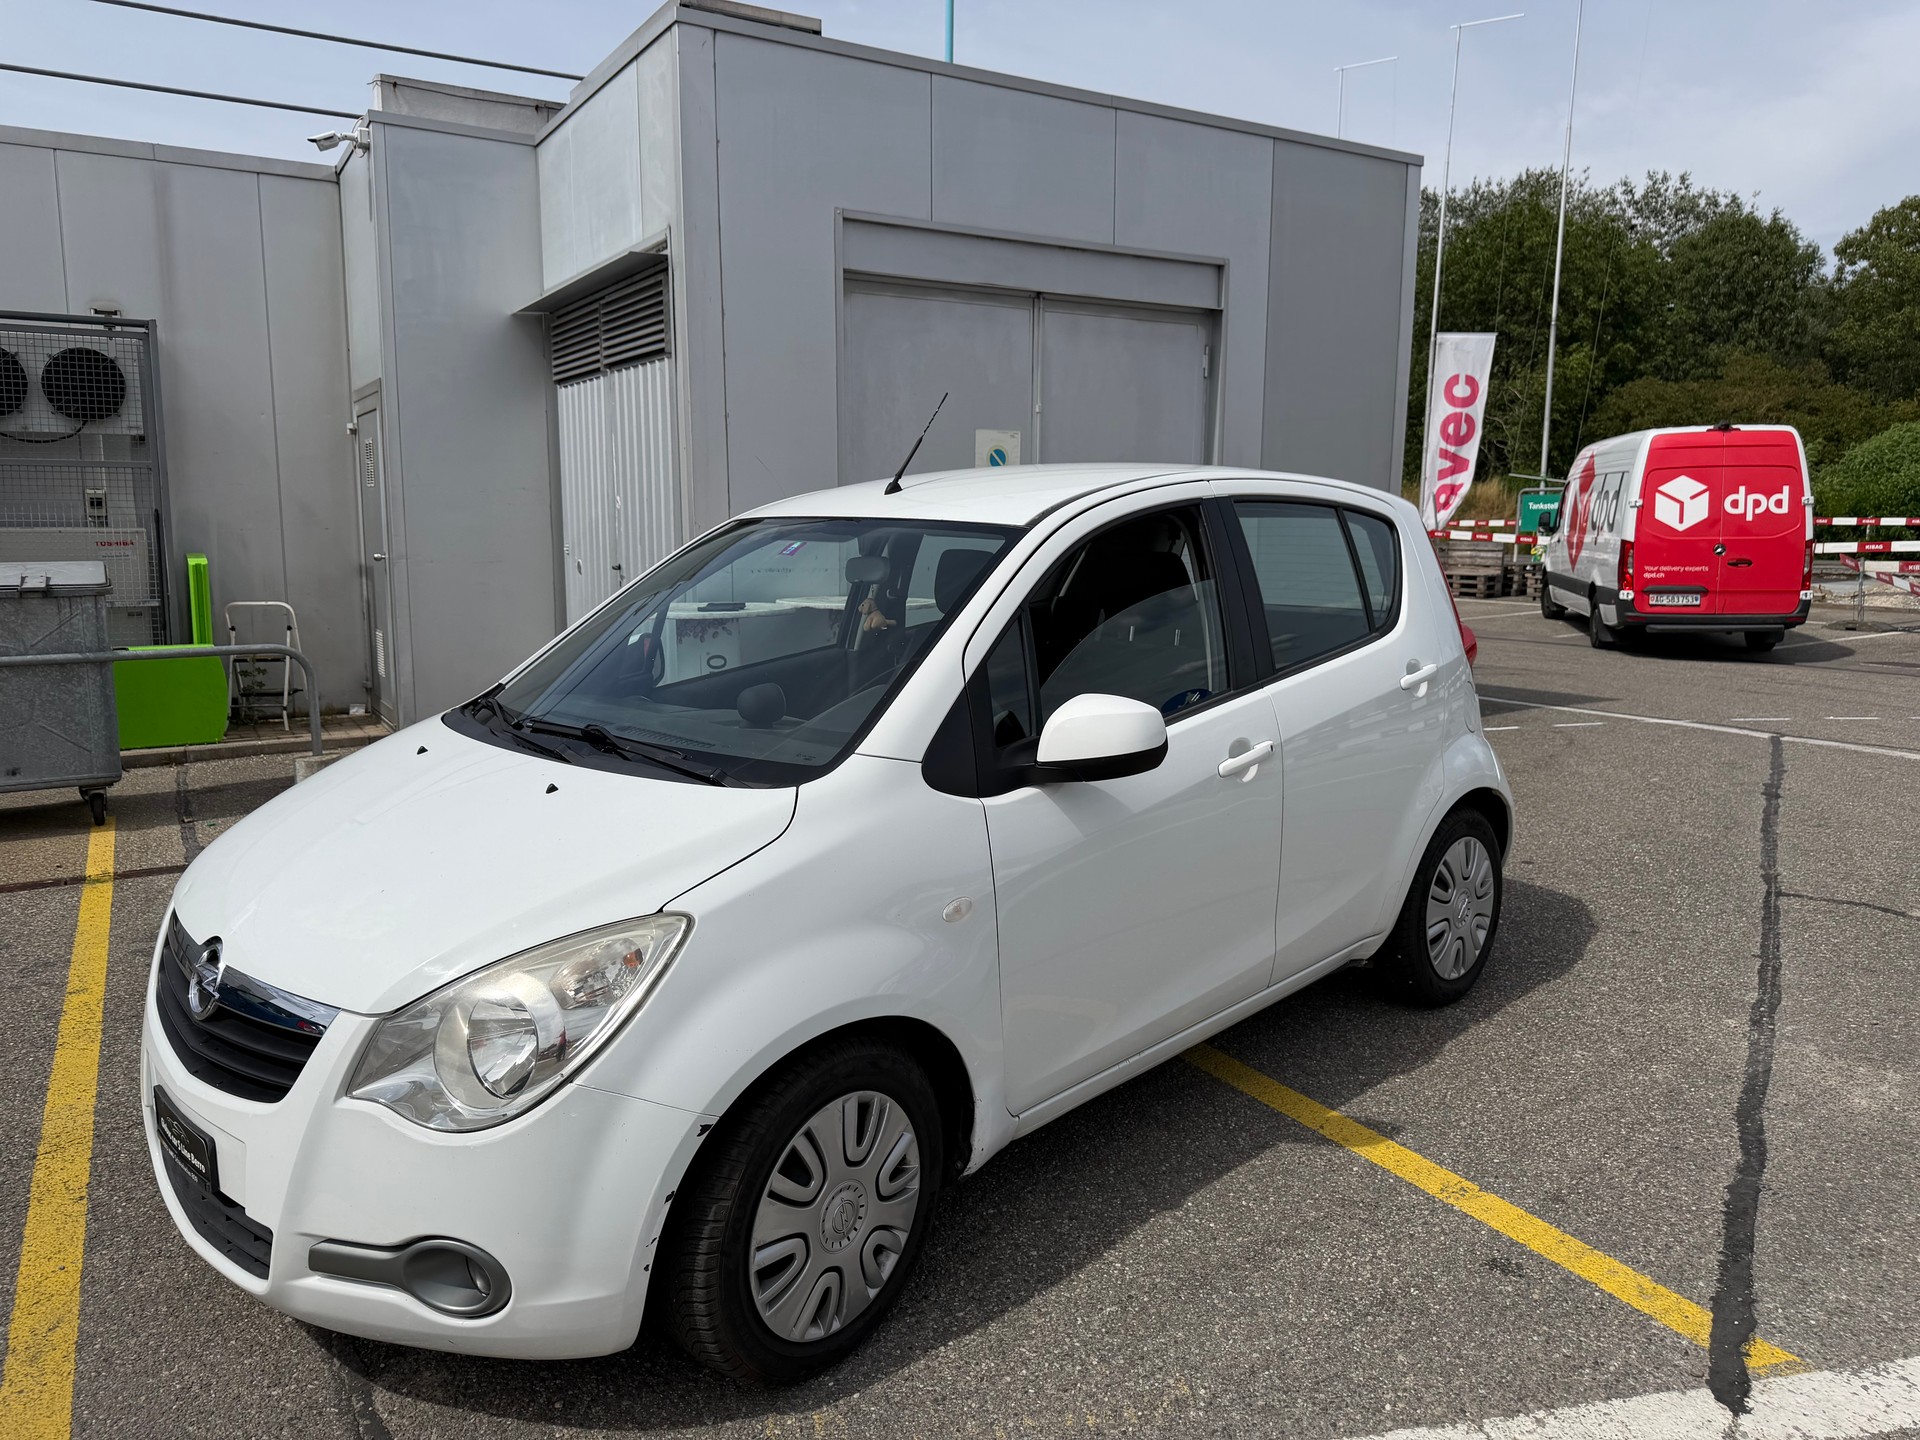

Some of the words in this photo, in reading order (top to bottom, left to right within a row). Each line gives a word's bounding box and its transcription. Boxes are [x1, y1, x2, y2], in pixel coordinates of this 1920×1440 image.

[1434, 373, 1480, 513] avec
[1528, 501, 1559, 510] Tankstell
[1591, 472, 1625, 546] dpd
[1723, 485, 1790, 521] dpd
[1643, 571, 1665, 579] dpd.ch
[1659, 565, 1684, 573] delivery
